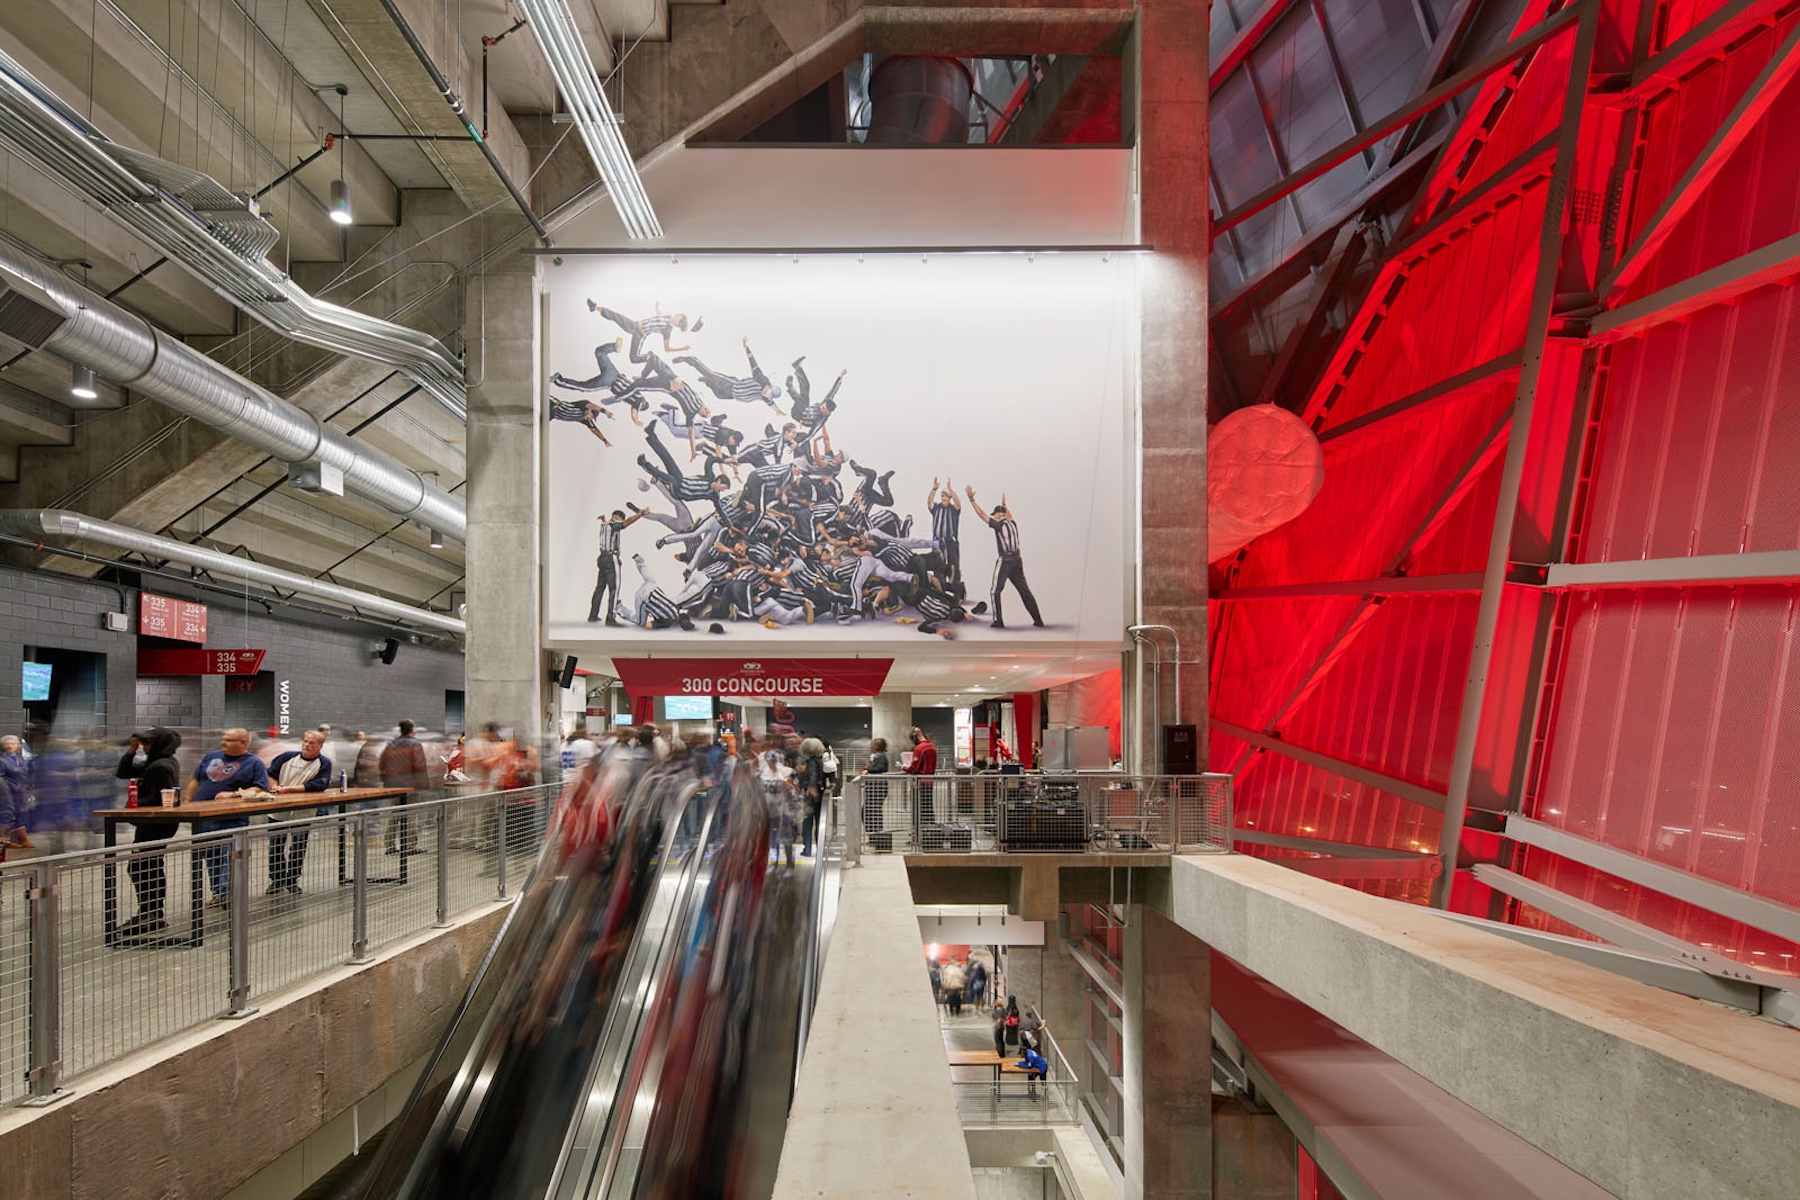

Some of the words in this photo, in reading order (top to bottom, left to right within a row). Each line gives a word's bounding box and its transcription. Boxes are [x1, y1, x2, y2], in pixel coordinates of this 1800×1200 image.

[151, 597, 165, 607] 335
[186, 604, 199, 613] 334
[151, 617, 165, 627] 335
[186, 623, 199, 632] 334
[217, 652, 236, 662] 334
[217, 663, 236, 673] 335
[682, 678, 712, 693] 300
[717, 678, 823, 693] CONCOURSE
[279, 680, 290, 735] WOMEN
